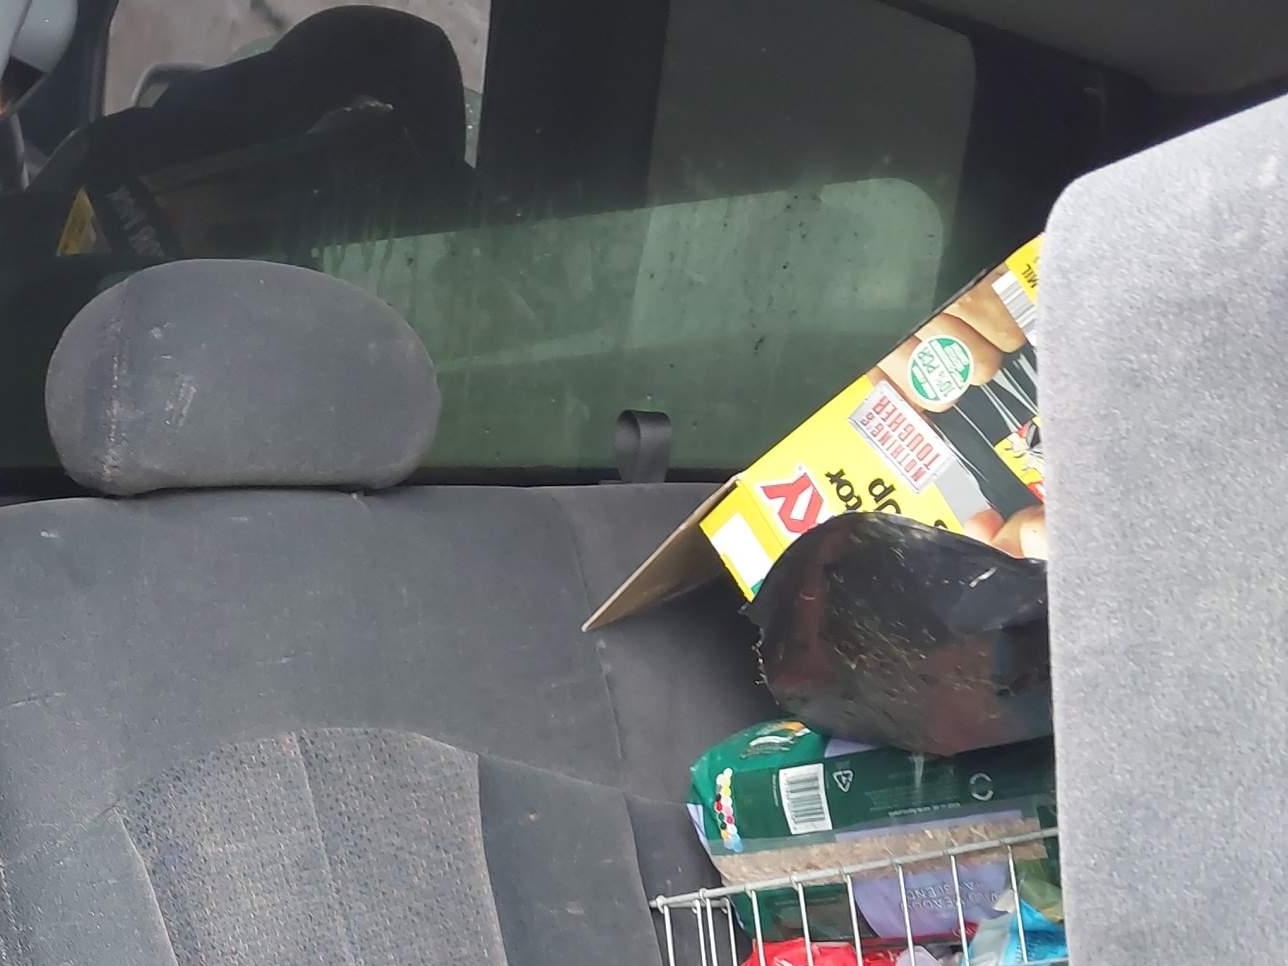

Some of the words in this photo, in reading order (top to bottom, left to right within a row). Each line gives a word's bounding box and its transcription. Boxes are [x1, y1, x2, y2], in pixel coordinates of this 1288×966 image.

[918, 347, 937, 373] PCR
[860, 411, 927, 482] NOTHING'S
[872, 395, 942, 471] TOUGHER
